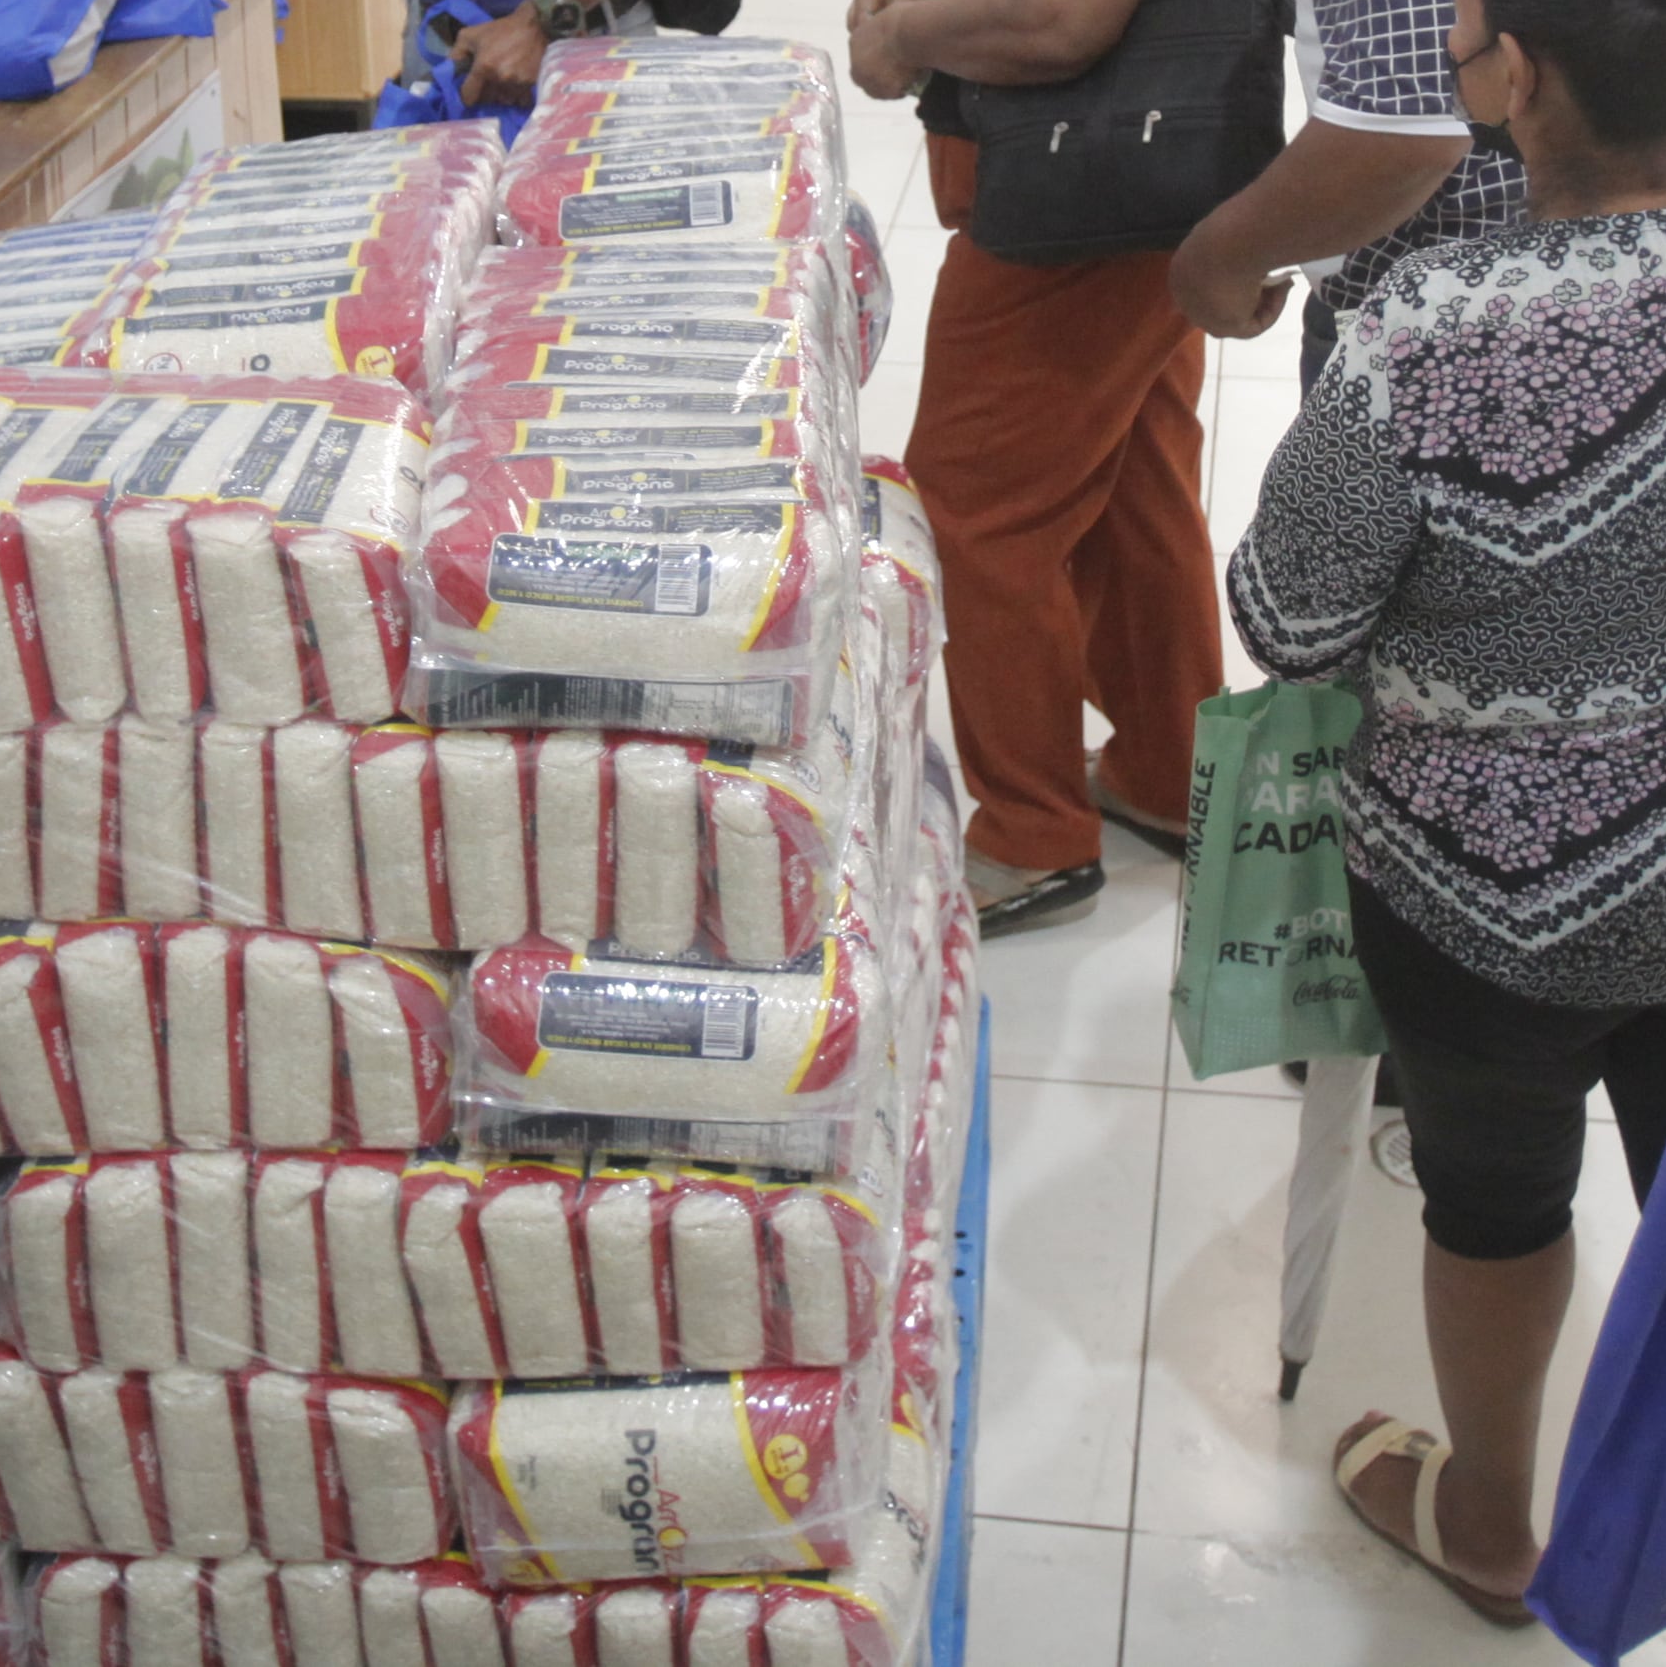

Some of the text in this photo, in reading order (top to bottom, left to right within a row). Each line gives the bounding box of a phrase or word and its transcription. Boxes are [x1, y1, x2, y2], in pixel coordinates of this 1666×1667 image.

[590, 321, 674, 334] Prograno
[564, 359, 650, 374] Prograno
[579, 400, 667, 413] Prograno
[546, 433, 638, 447] Prograno
[582, 478, 675, 493] Prograno
[559, 512, 654, 529] Prograno
[590, 506, 636, 520] Arroz
[1256, 746, 1346, 777] N SAB
[1249, 775, 1340, 816] ARA
[1234, 813, 1339, 855] CADA
[1273, 907, 1349, 940] #BOT
[1218, 934, 1358, 968] RETORN
[619, 1429, 659, 1572] Progran
